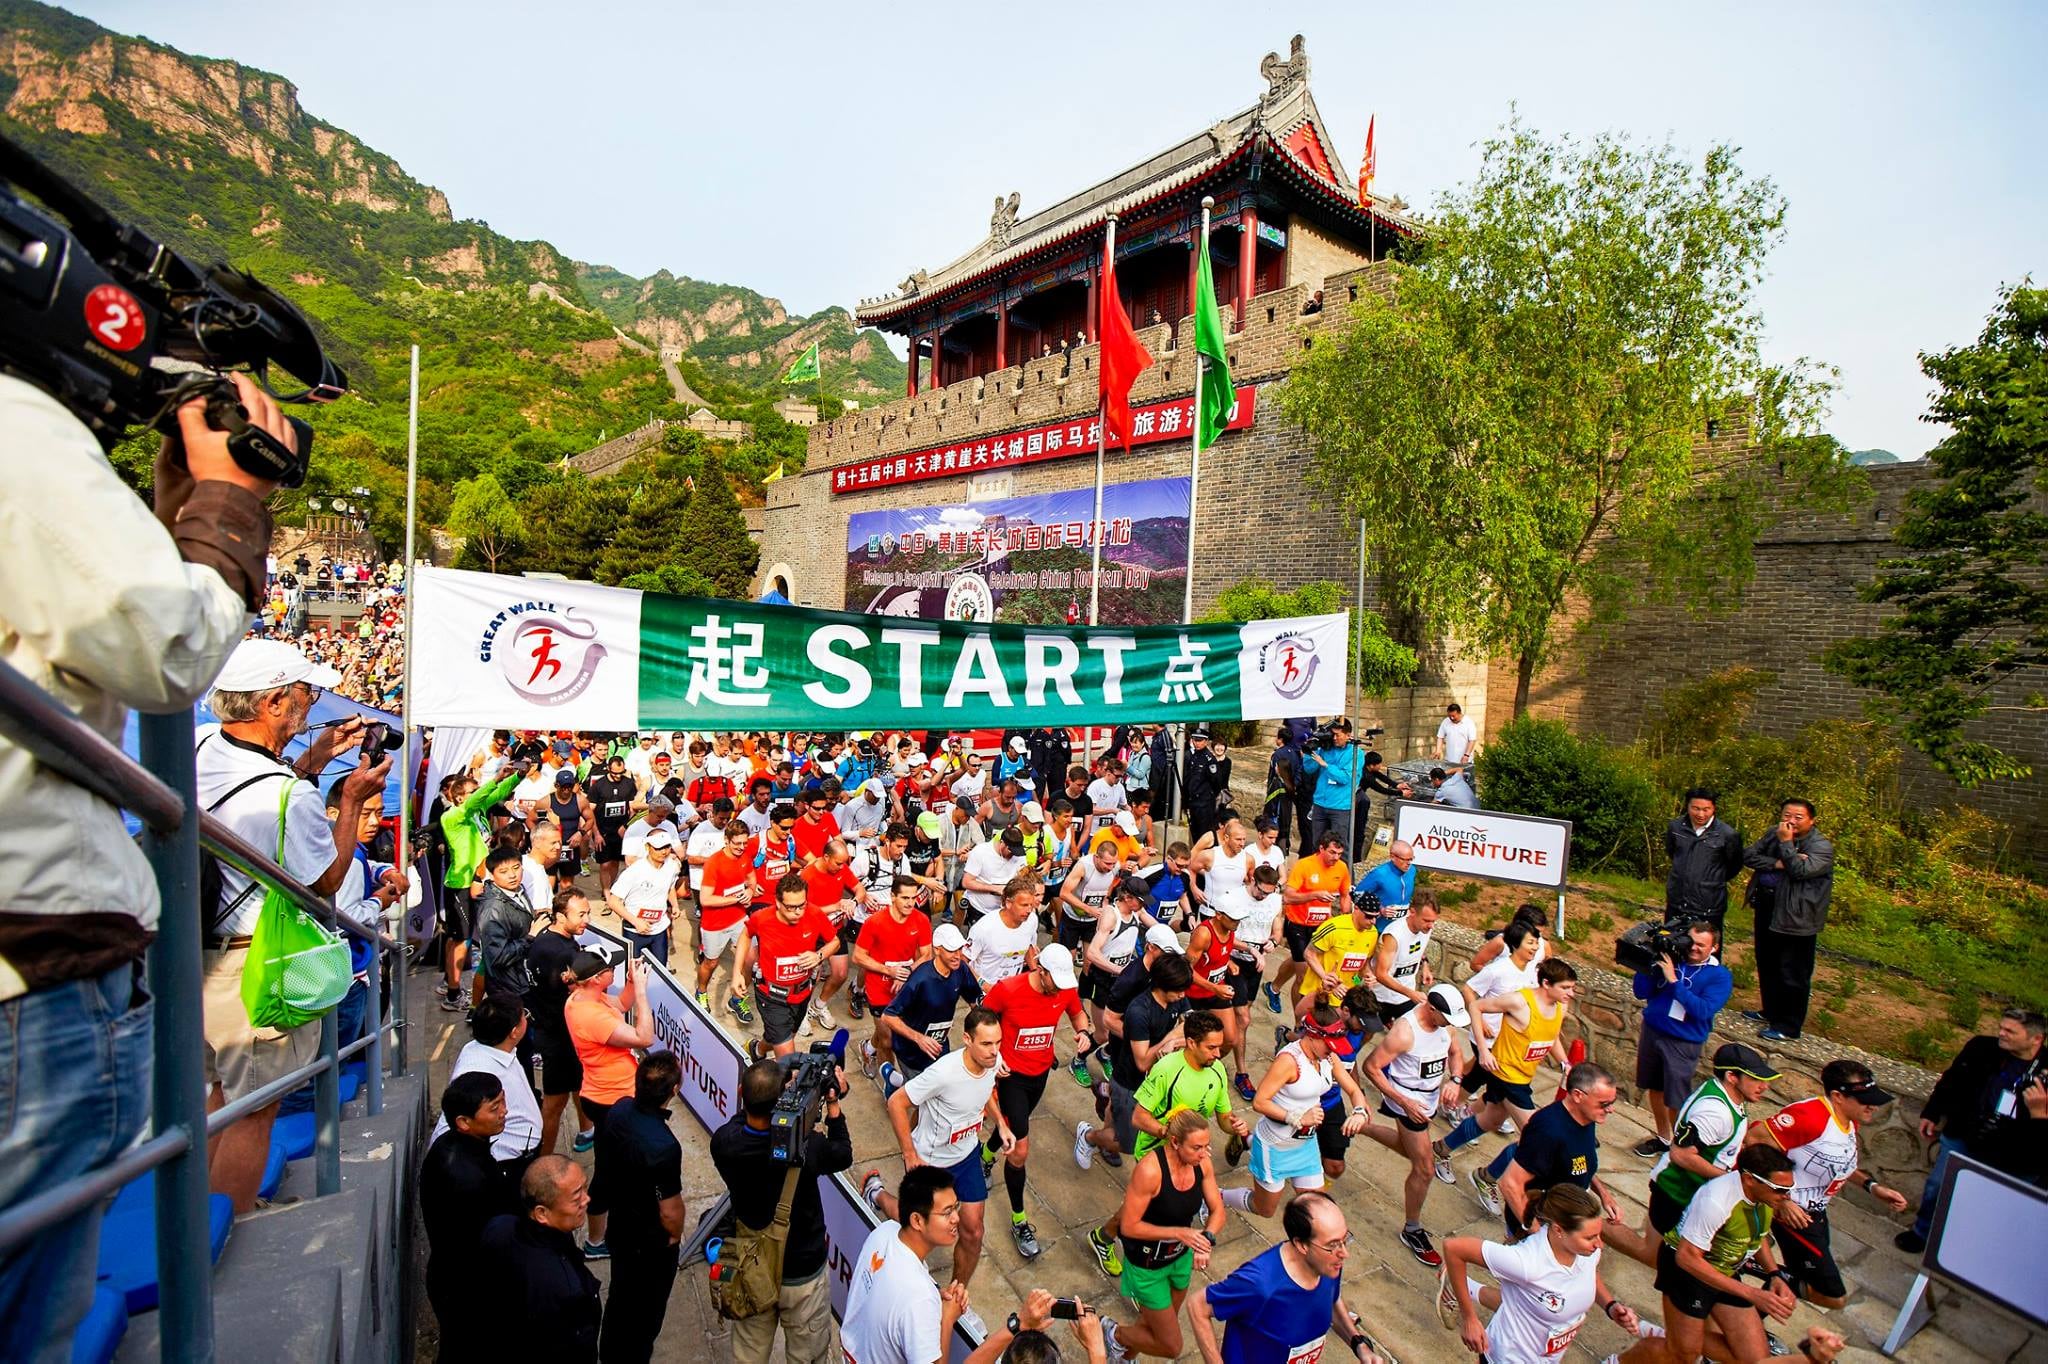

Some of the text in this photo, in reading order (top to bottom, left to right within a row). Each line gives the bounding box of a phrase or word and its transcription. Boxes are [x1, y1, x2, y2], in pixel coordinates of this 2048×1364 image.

[98, 303, 128, 344] 2
[249, 438, 287, 470] Canon
[837, 401, 1239, 488] 第十五届中国·天津黄崖关长城国际马拉旅游
[900, 516, 1132, 554] 中国·黄崖关长城国际马拉松
[989, 570, 1037, 590] Celebrate
[1039, 569, 1071, 589] China
[1073, 567, 1122, 589] Touism
[1125, 565, 1151, 591] Day
[480, 601, 556, 662] GREAT WALL
[684, 614, 1215, 709] 起 START 点
[549, 670, 590, 704] MARATHON
[1412, 833, 1547, 867] ADVENTURE
[1429, 824, 1487, 842] Albatros
[658, 1002, 691, 1050] Albatros
[931, 1030, 945, 1040] 154
[1024, 1036, 1046, 1045] 2153
[1427, 1061, 1443, 1074] 165
